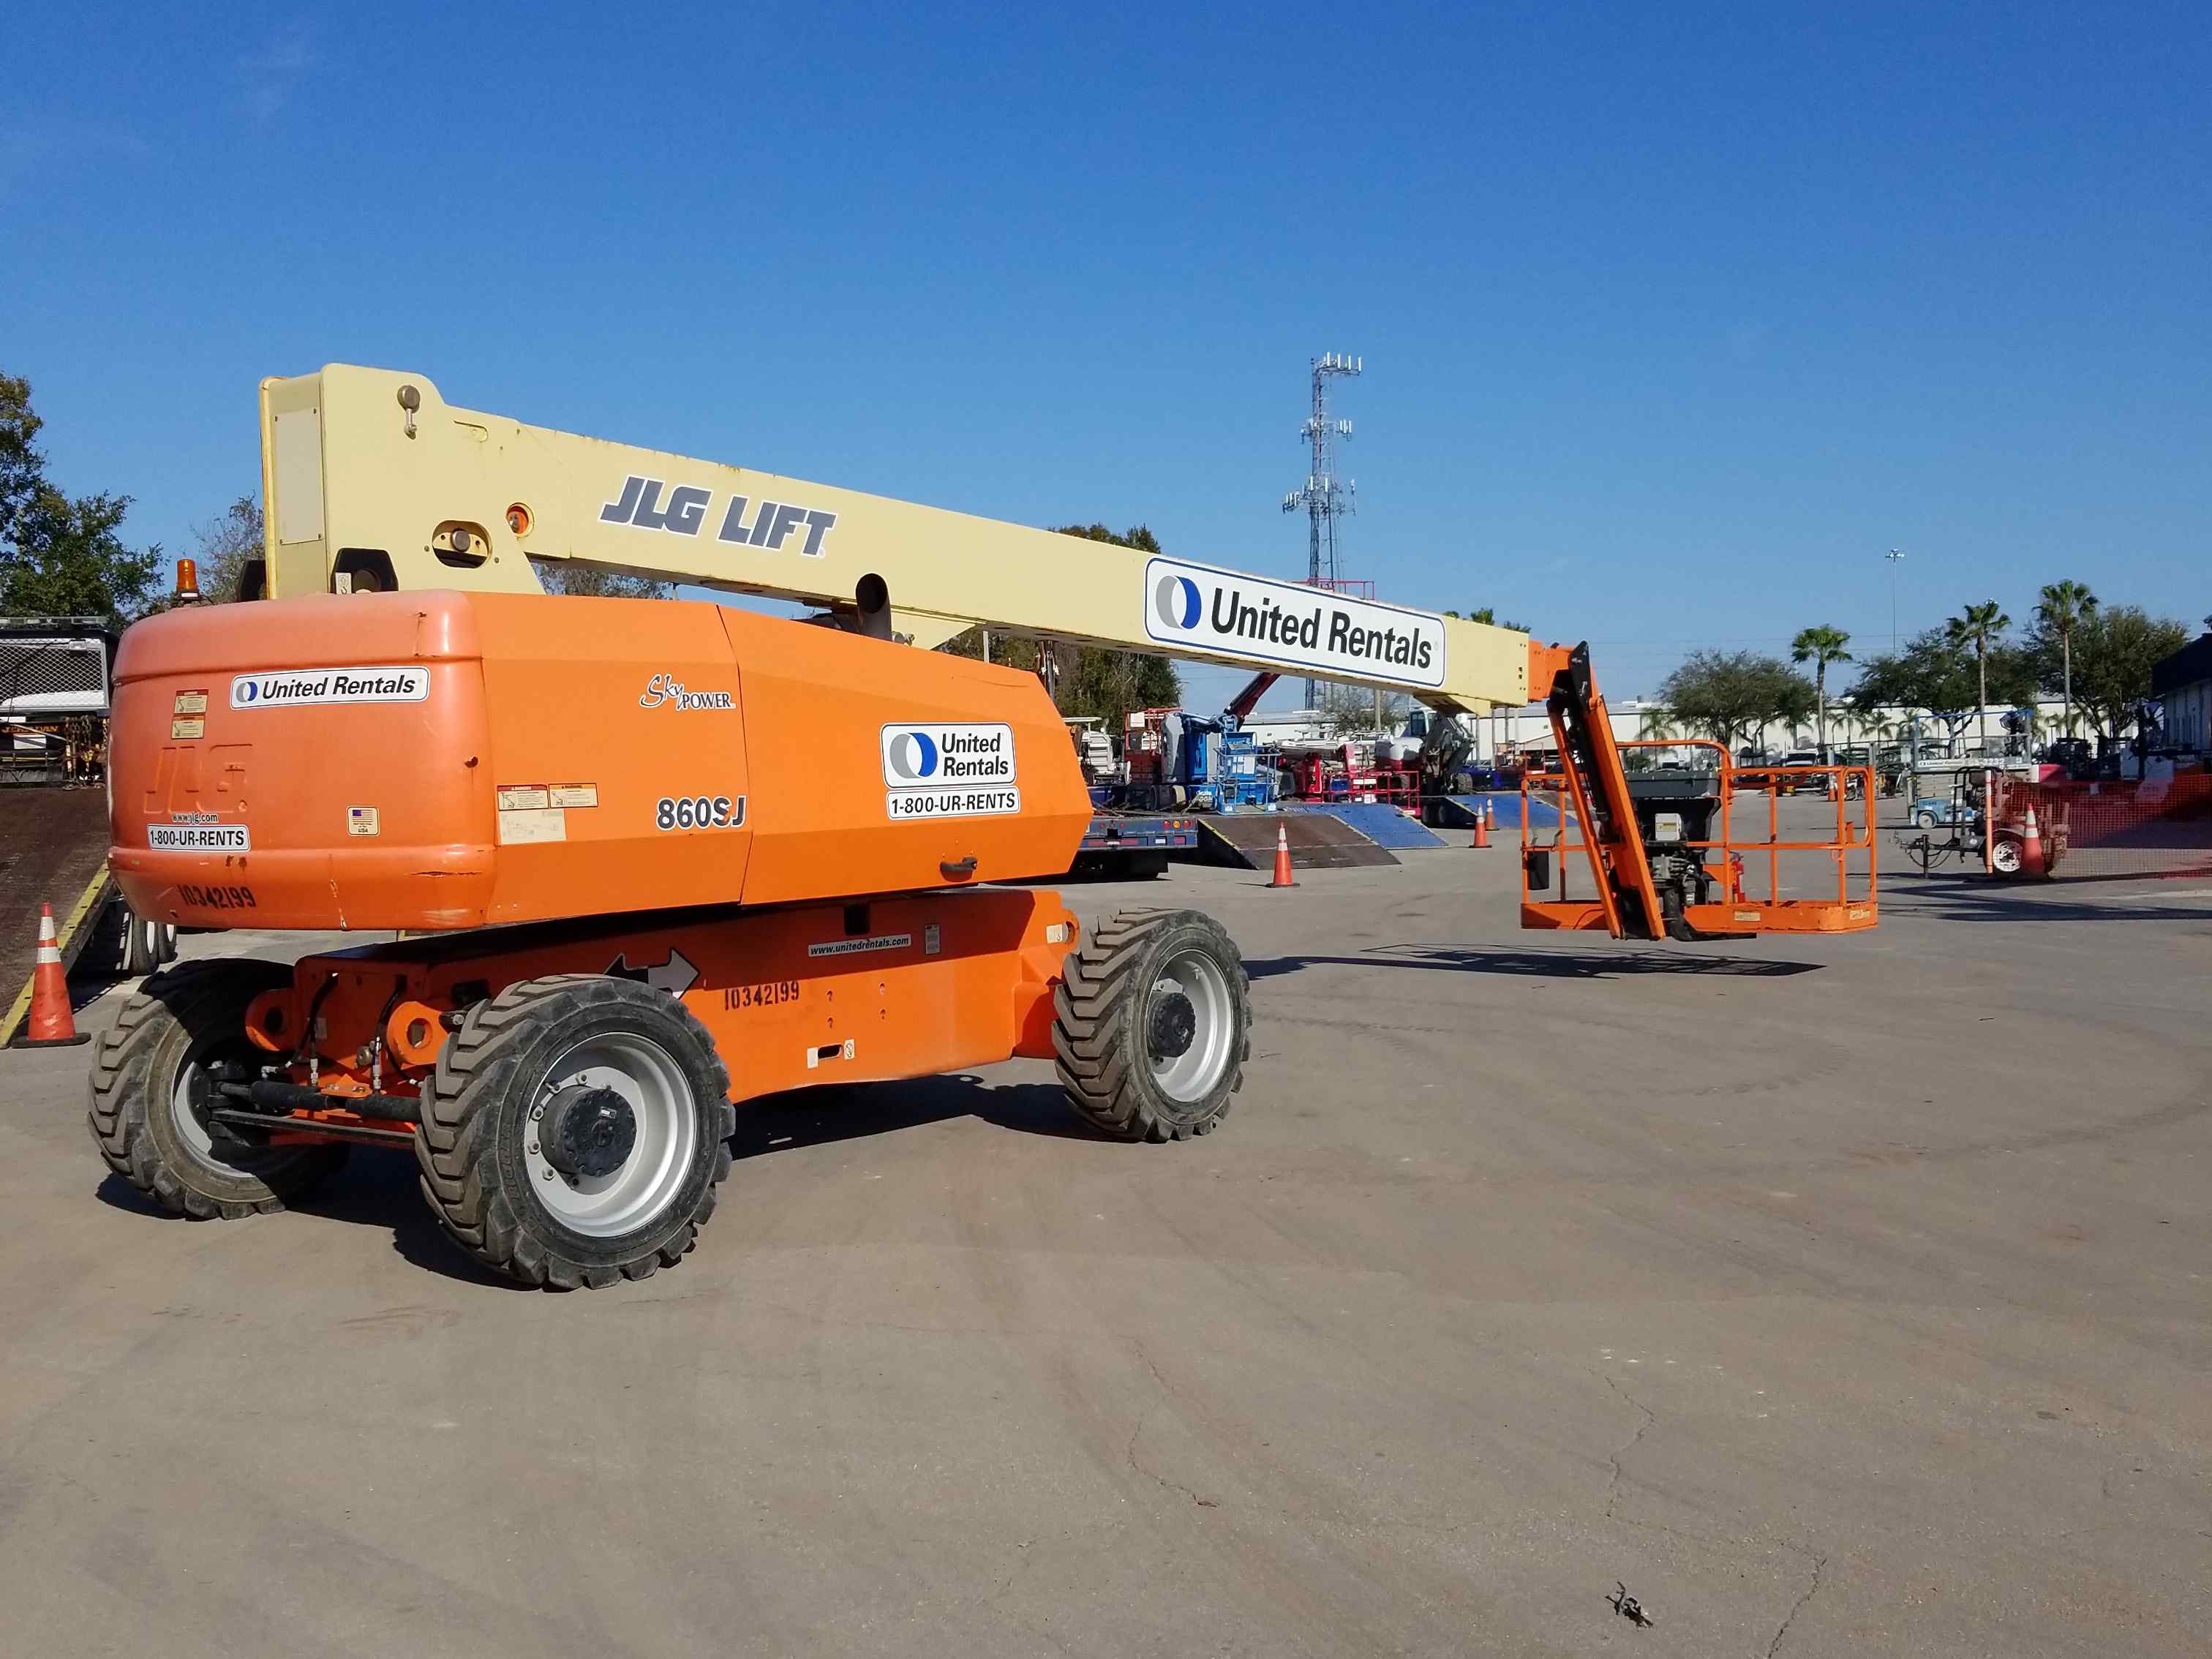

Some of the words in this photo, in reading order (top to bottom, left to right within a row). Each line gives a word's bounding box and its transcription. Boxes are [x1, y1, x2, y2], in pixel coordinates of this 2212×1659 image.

[598, 475, 713, 537] JLG
[716, 494, 838, 556] LIFT
[1211, 587, 1322, 649] United
[1327, 610, 1432, 669] Rentals
[262, 677, 328, 700] United
[332, 674, 416, 696] Rentals
[640, 674, 685, 710] Sky
[682, 693, 732, 709] POWER
[941, 732, 1001, 753] United
[943, 755, 1009, 777] Rentals
[656, 796, 747, 830] 860SJ
[892, 792, 1015, 814] 1-800-UR-RENTS
[172, 812, 219, 824] www.jlg.com
[150, 830, 244, 846] 1-800-UR-RENTS
[176, 884, 257, 909] 10342199
[810, 936, 909, 955] www.unitedrentals.com
[723, 980, 800, 1011] 10342199
